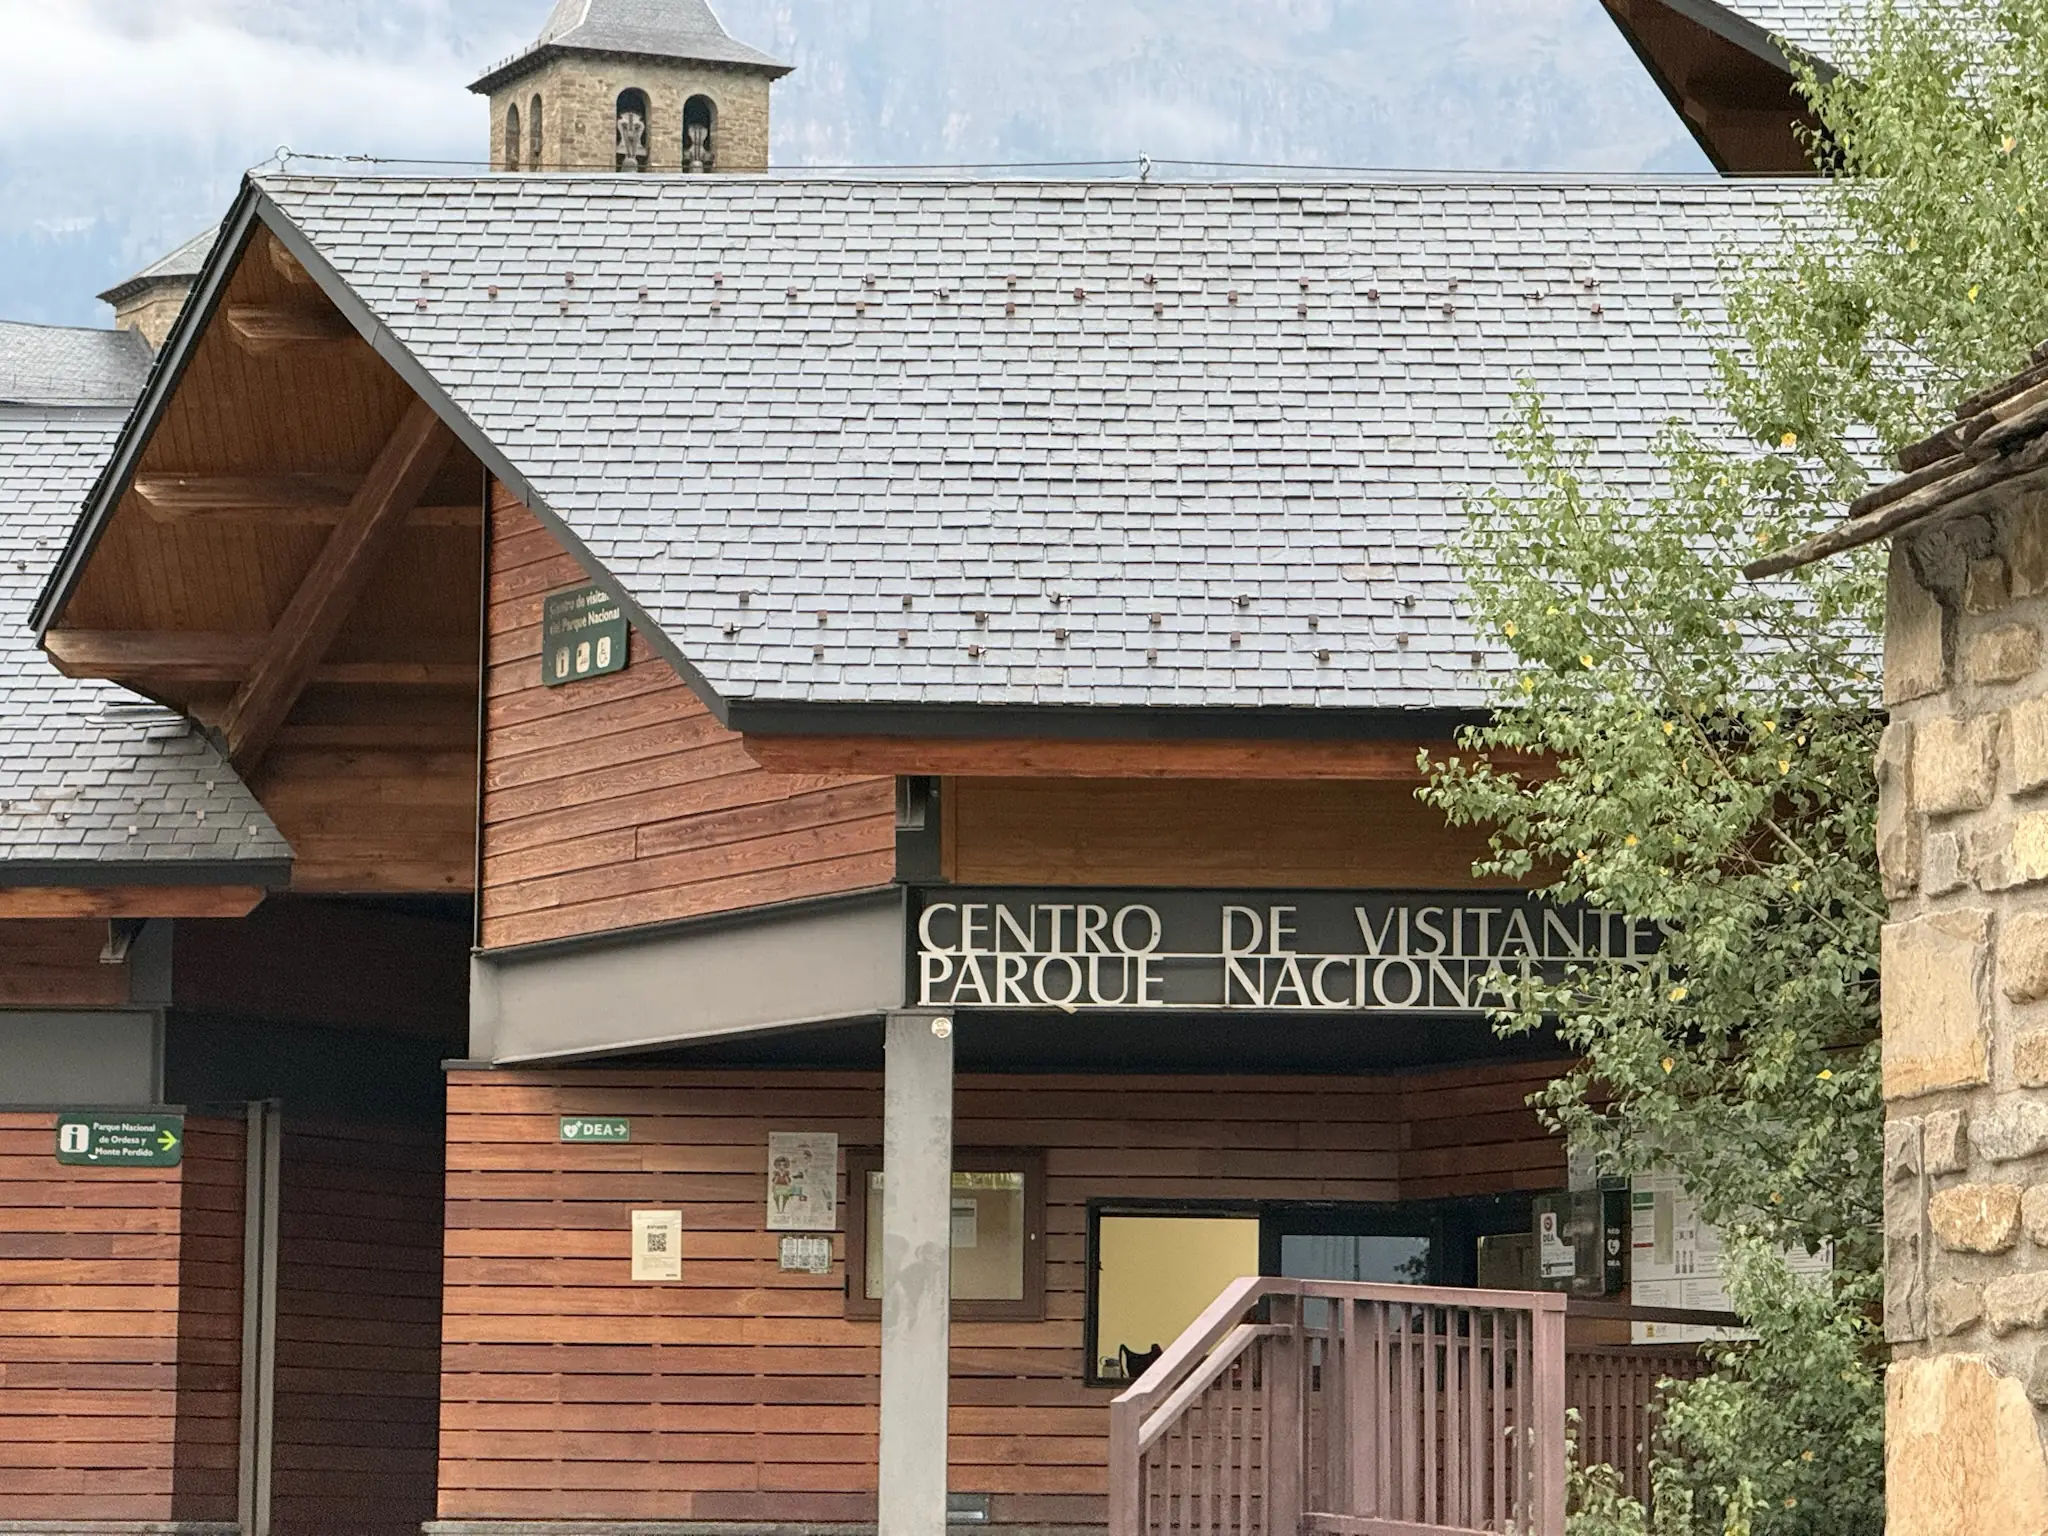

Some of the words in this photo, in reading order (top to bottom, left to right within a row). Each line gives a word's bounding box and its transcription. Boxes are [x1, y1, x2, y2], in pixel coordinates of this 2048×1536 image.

[588, 607, 620, 626] Nacional
[918, 902, 1162, 954] CENTRO
[1222, 906, 1297, 956] DE
[917, 953, 1164, 1014] PARQUE
[93, 1122, 120, 1132] Parque
[121, 1123, 156, 1132] Nacional
[583, 1123, 613, 1136] DEA
[98, 1135, 109, 1144] de
[110, 1135, 139, 1144] Ordesa
[140, 1137, 147, 1146] y
[95, 1147, 120, 1156] Monte
[122, 1148, 154, 1157] Perdido
